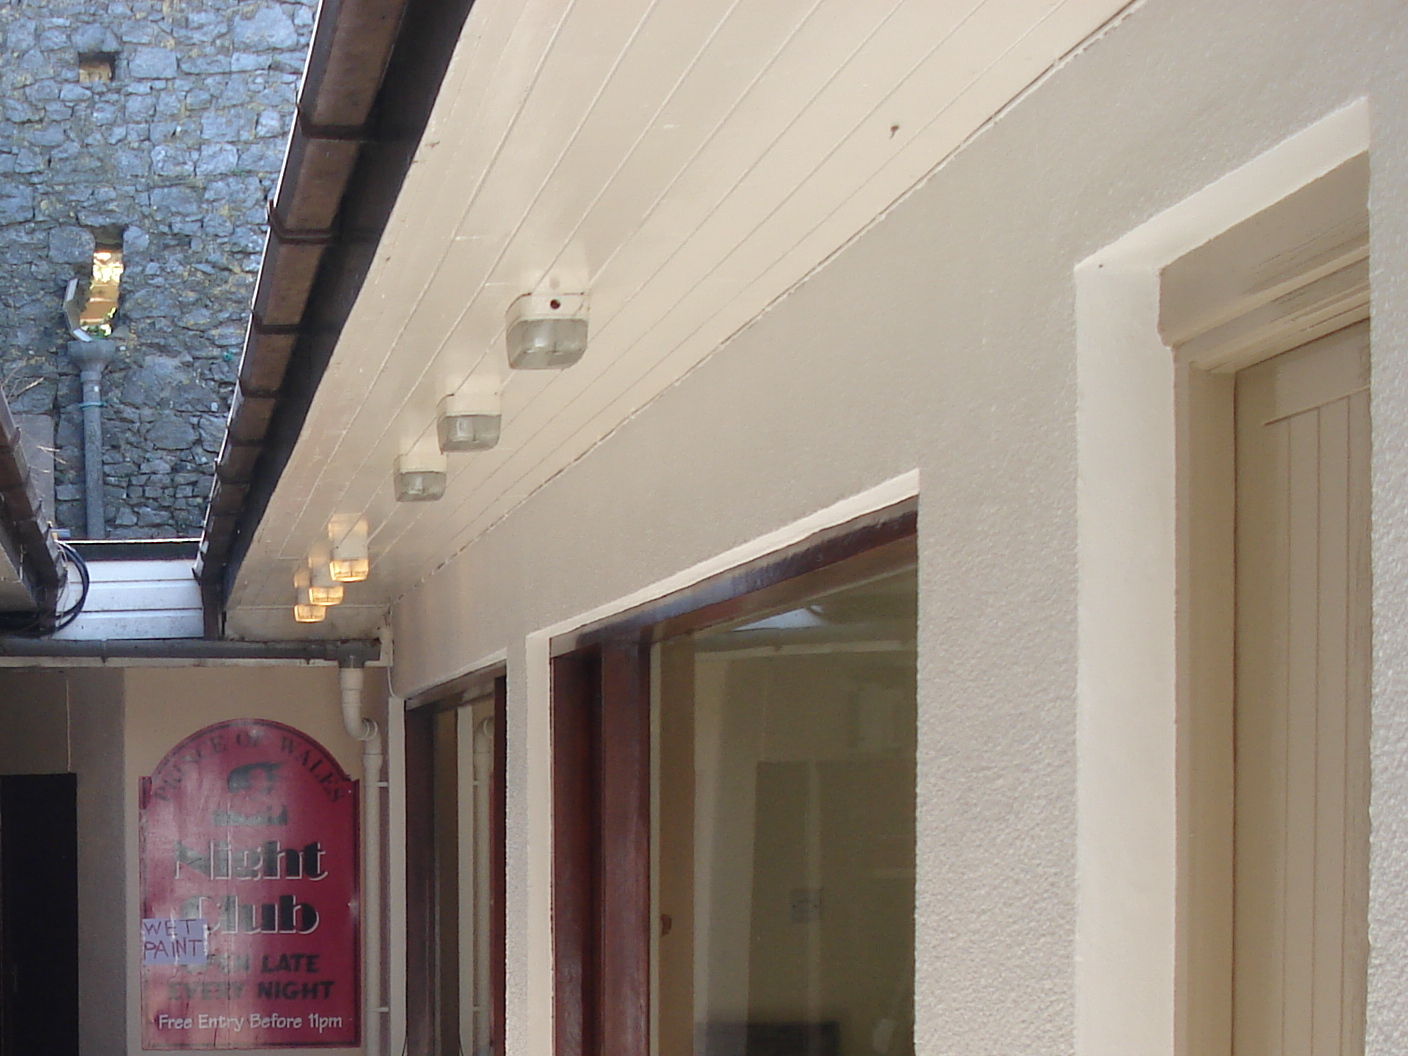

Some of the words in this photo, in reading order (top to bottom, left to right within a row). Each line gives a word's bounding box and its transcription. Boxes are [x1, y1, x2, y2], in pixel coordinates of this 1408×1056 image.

[279, 736, 347, 803] WALES
[173, 840, 330, 881] Night
[180, 895, 319, 936] Club
[143, 918, 198, 937] WET
[143, 937, 204, 961] PAINT
[261, 953, 321, 974] LATE
[168, 981, 247, 1001] EVERY
[256, 981, 336, 1001] NIGHT
[158, 1013, 193, 1030] Free
[197, 1013, 245, 1033] Entry
[249, 1012, 303, 1031] Before
[308, 1012, 343, 1035] 11pm
